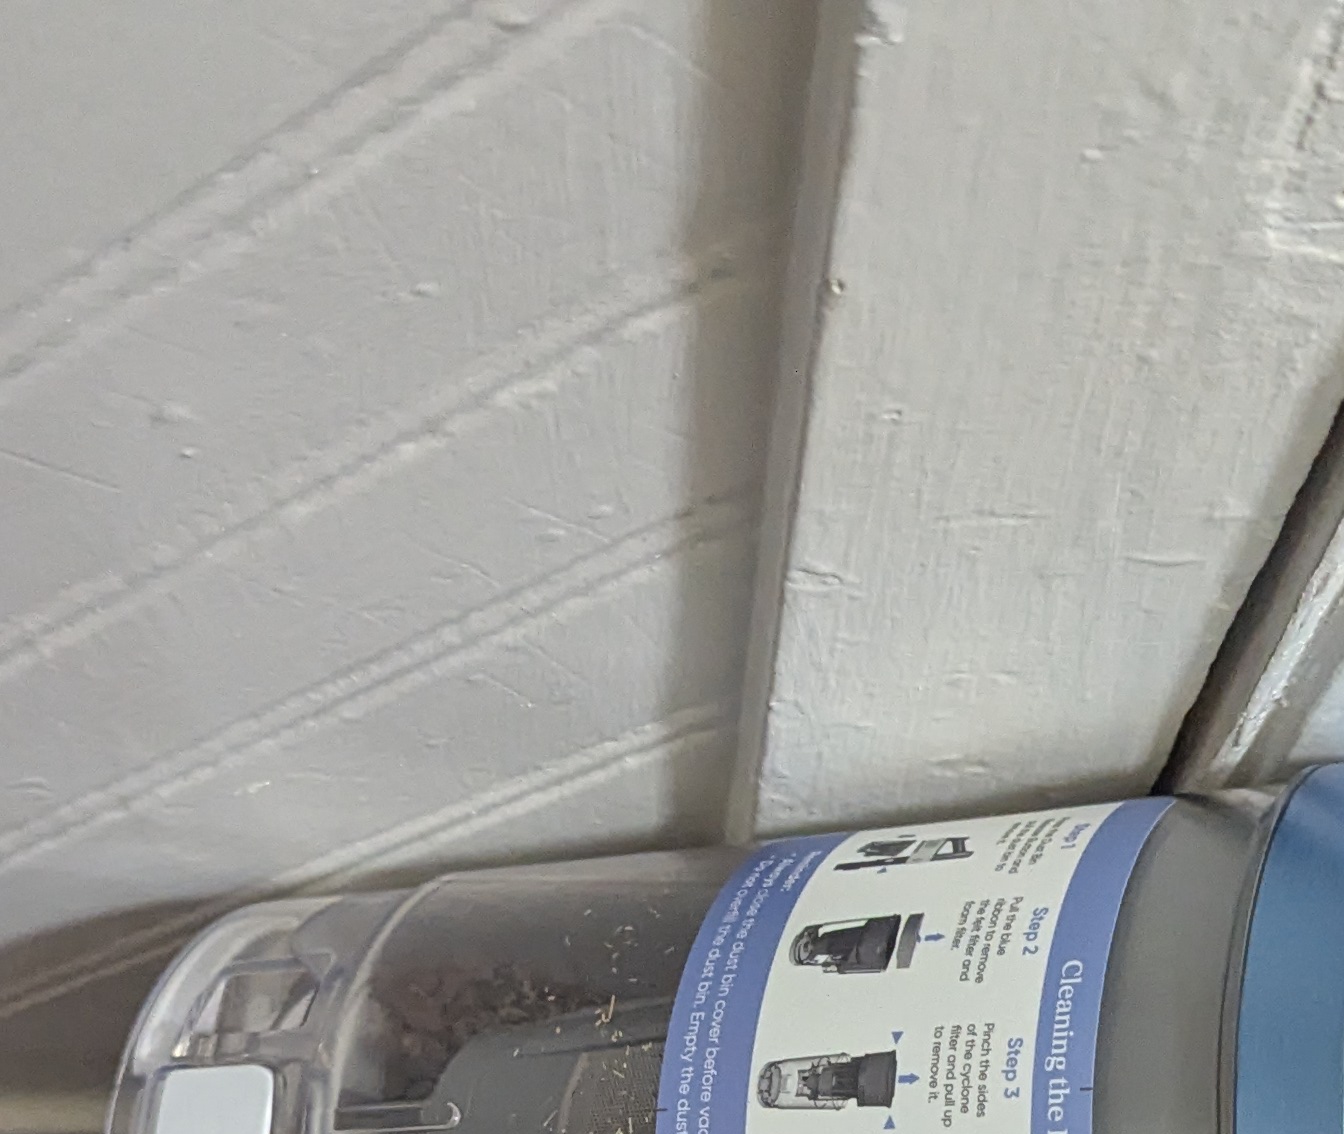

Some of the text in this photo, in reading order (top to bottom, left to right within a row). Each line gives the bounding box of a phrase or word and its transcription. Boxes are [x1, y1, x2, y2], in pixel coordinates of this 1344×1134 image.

[746, 889, 770, 916] close
[958, 900, 976, 925] foam
[977, 899, 990, 915] the
[712, 924, 731, 946] the
[736, 918, 755, 939] the
[964, 934, 980, 957] filter
[975, 898, 1006, 984] ribbon to remove
[997, 896, 1024, 956] Pull the blue
[1022, 908, 1049, 956] Step 2
[701, 948, 721, 978] dust
[725, 942, 744, 971] dust
[959, 959, 971, 982] and
[693, 982, 712, 1008] bin.
[718, 974, 737, 996] bin
[680, 1012, 705, 1062] Empty
[708, 1000, 726, 1044] cover
[1044, 960, 1083, 1072] Cleaning
[679, 1066, 694, 1094] the
[700, 1048, 720, 1102] before
[928, 1026, 945, 1104] to remove it.
[941, 1025, 962, 1128] filter and pull up
[960, 1024, 977, 1114] of the cyclone
[976, 1023, 995, 1118] Pinch the sides
[1001, 1038, 1024, 1099] Step 3
[1048, 1077, 1071, 1121] the
